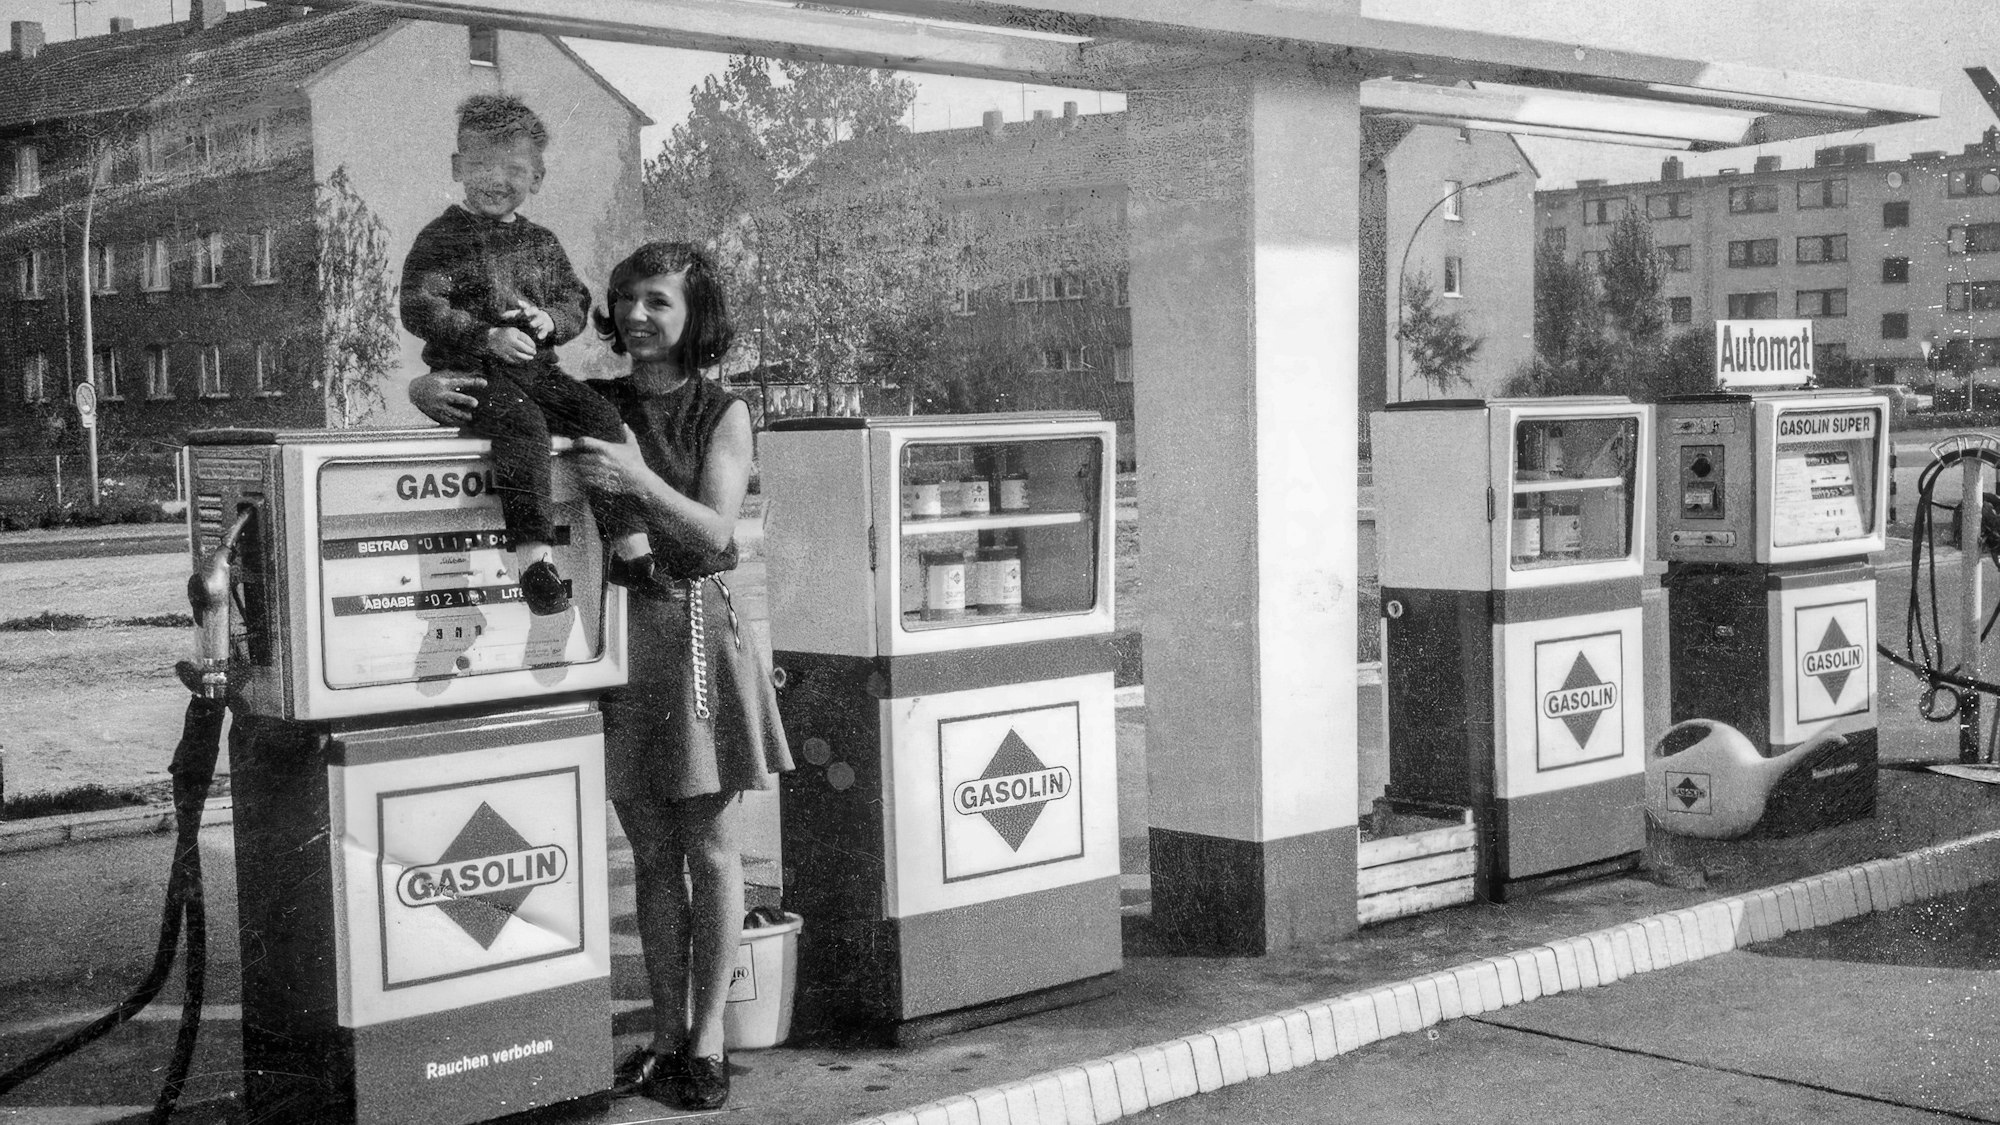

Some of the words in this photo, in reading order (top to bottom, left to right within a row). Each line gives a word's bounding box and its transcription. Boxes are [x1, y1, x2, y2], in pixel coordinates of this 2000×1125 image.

[1720, 325, 1810, 372] Automat
[1780, 418, 1830, 436] GASOLIN
[1832, 416, 1870, 433] SUPER
[358, 539, 409, 554] BETRAG
[364, 596, 415, 610] ABGABE
[1807, 649, 1860, 672] GASOLIN
[1549, 687, 1613, 714] GASOLIN
[961, 772, 1063, 809] GASOLIN
[407, 851, 556, 900] GASOLIN
[427, 1055, 489, 1079] Rauchen
[492, 1040, 553, 1064] verboten
